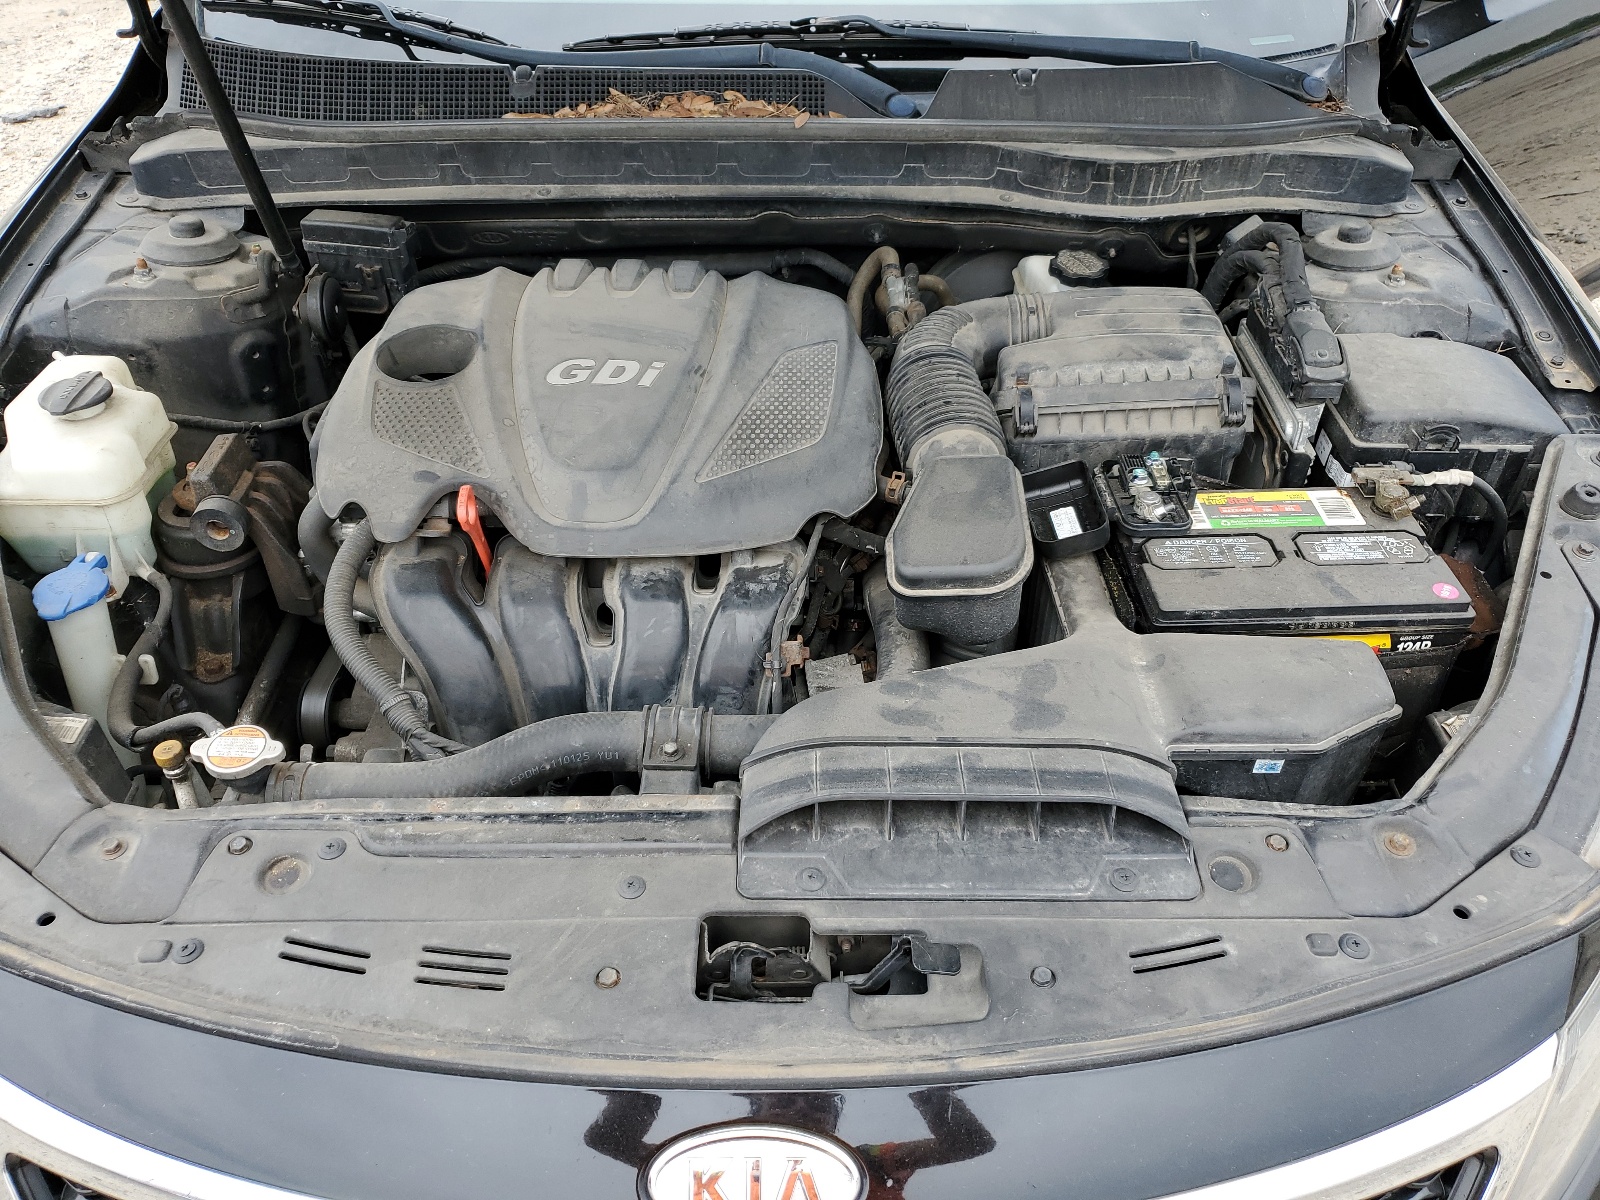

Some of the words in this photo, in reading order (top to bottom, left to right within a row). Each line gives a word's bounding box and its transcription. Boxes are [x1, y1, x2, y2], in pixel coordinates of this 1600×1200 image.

[546, 358, 667, 388] GDi
[551, 751, 590, 768] 110125
[597, 751, 620, 760] YU1
[687, 1156, 822, 1200] KIA
